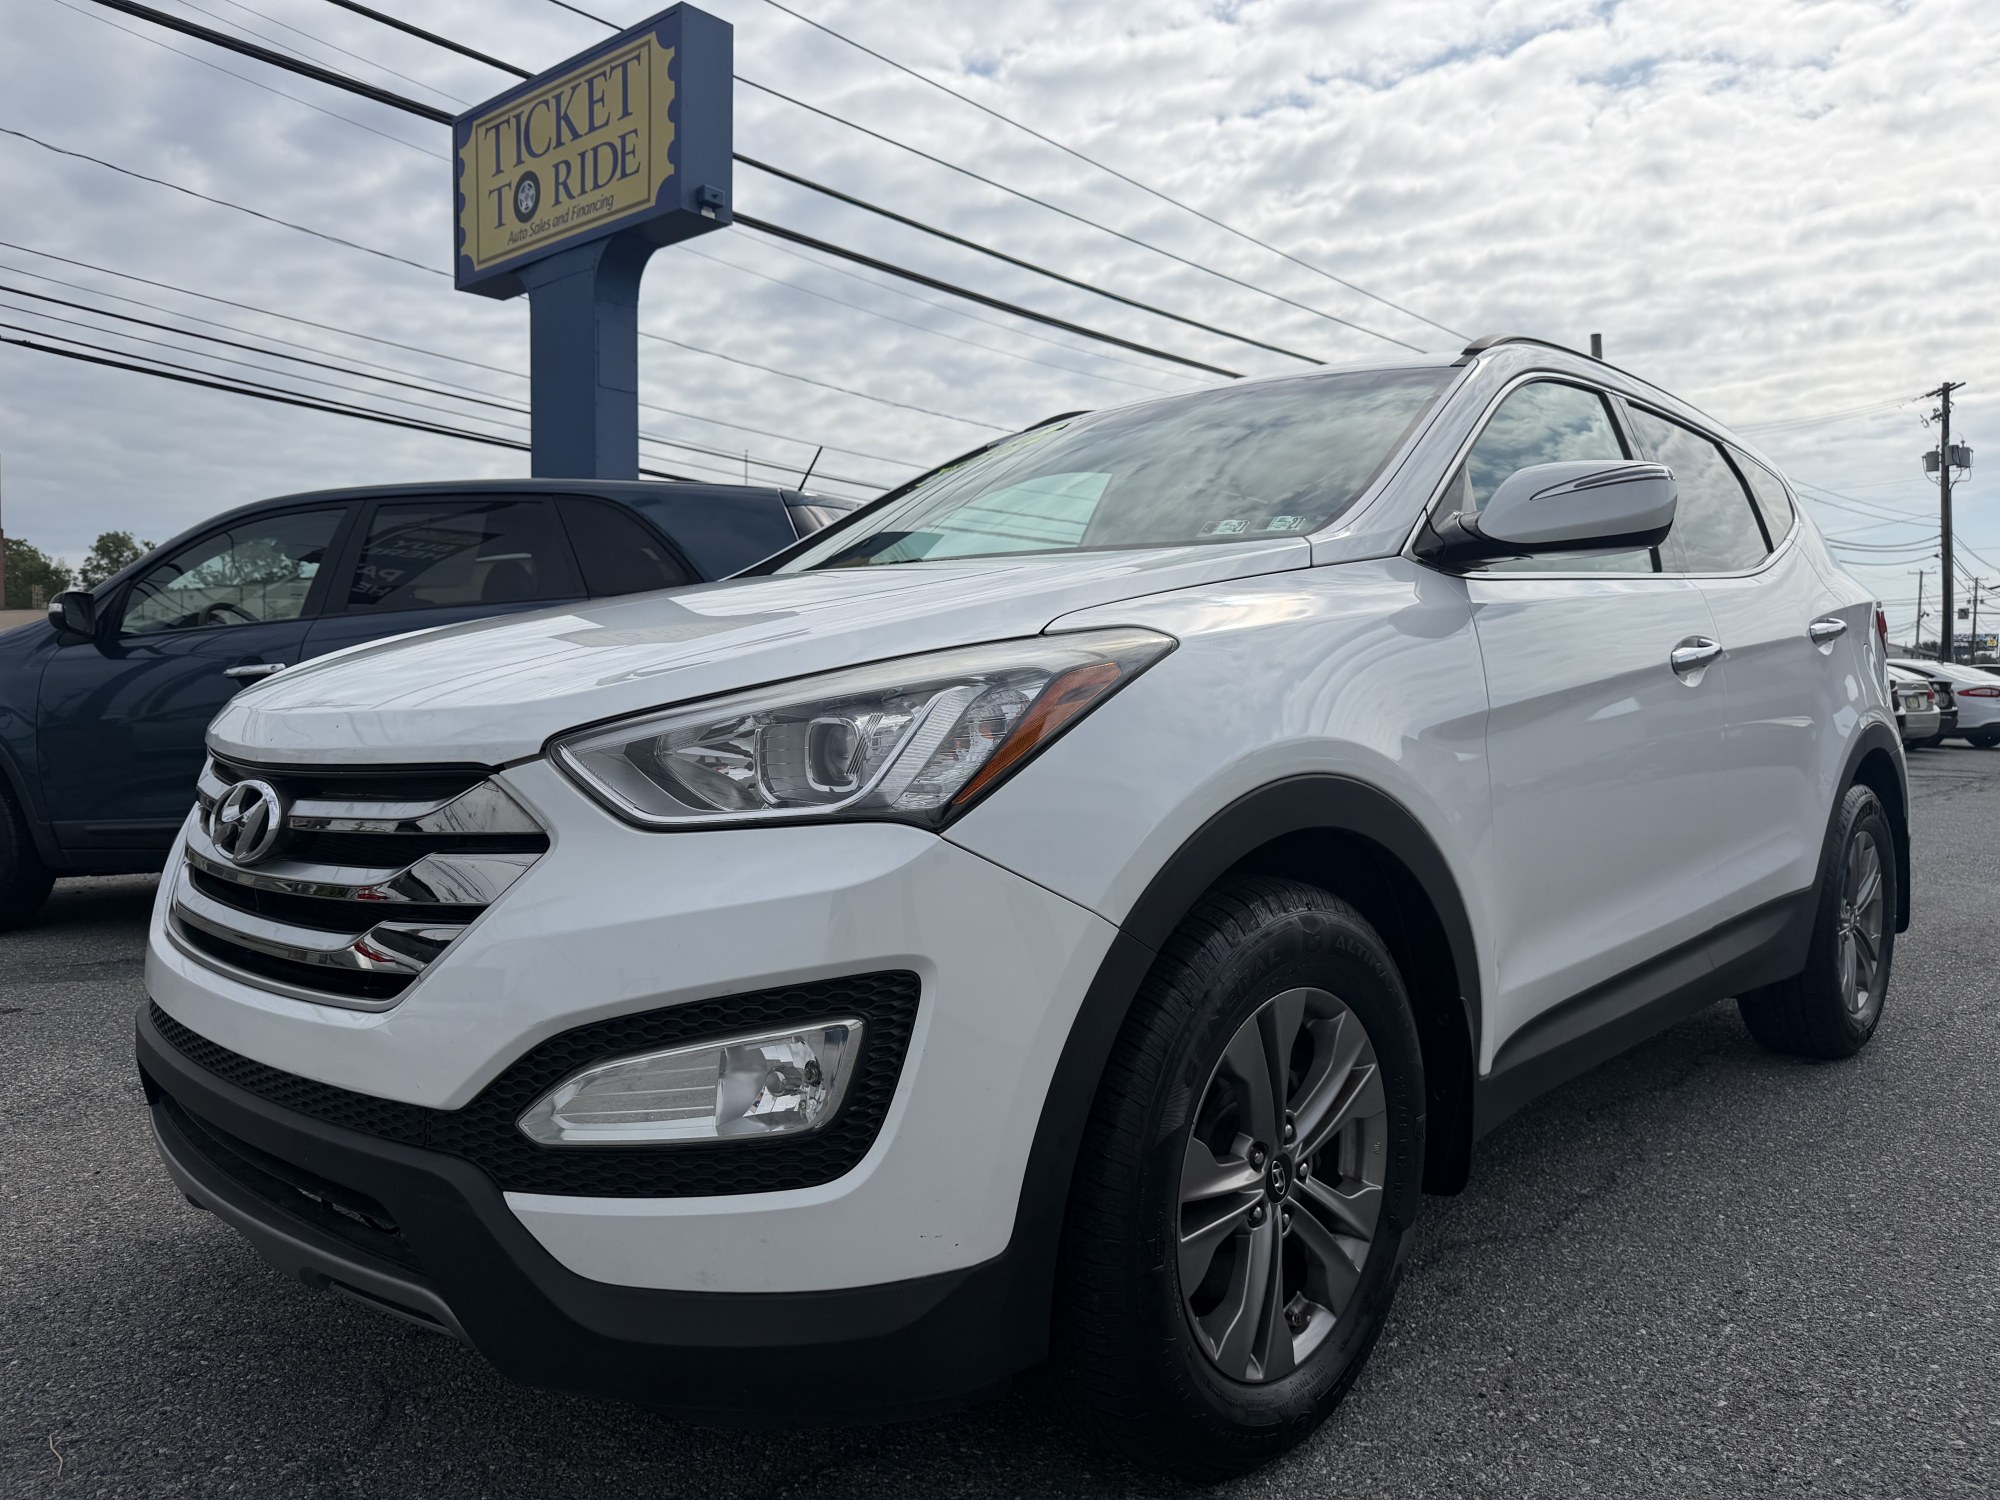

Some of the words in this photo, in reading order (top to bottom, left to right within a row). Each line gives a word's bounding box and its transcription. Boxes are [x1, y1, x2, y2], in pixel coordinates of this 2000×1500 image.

[484, 51, 641, 177] TICKET
[488, 170, 541, 229] TO
[551, 128, 641, 208] RIDE
[507, 228, 528, 246] Auto
[529, 218, 551, 238] Sales
[552, 207, 570, 228] and
[571, 194, 614, 221] Financing
